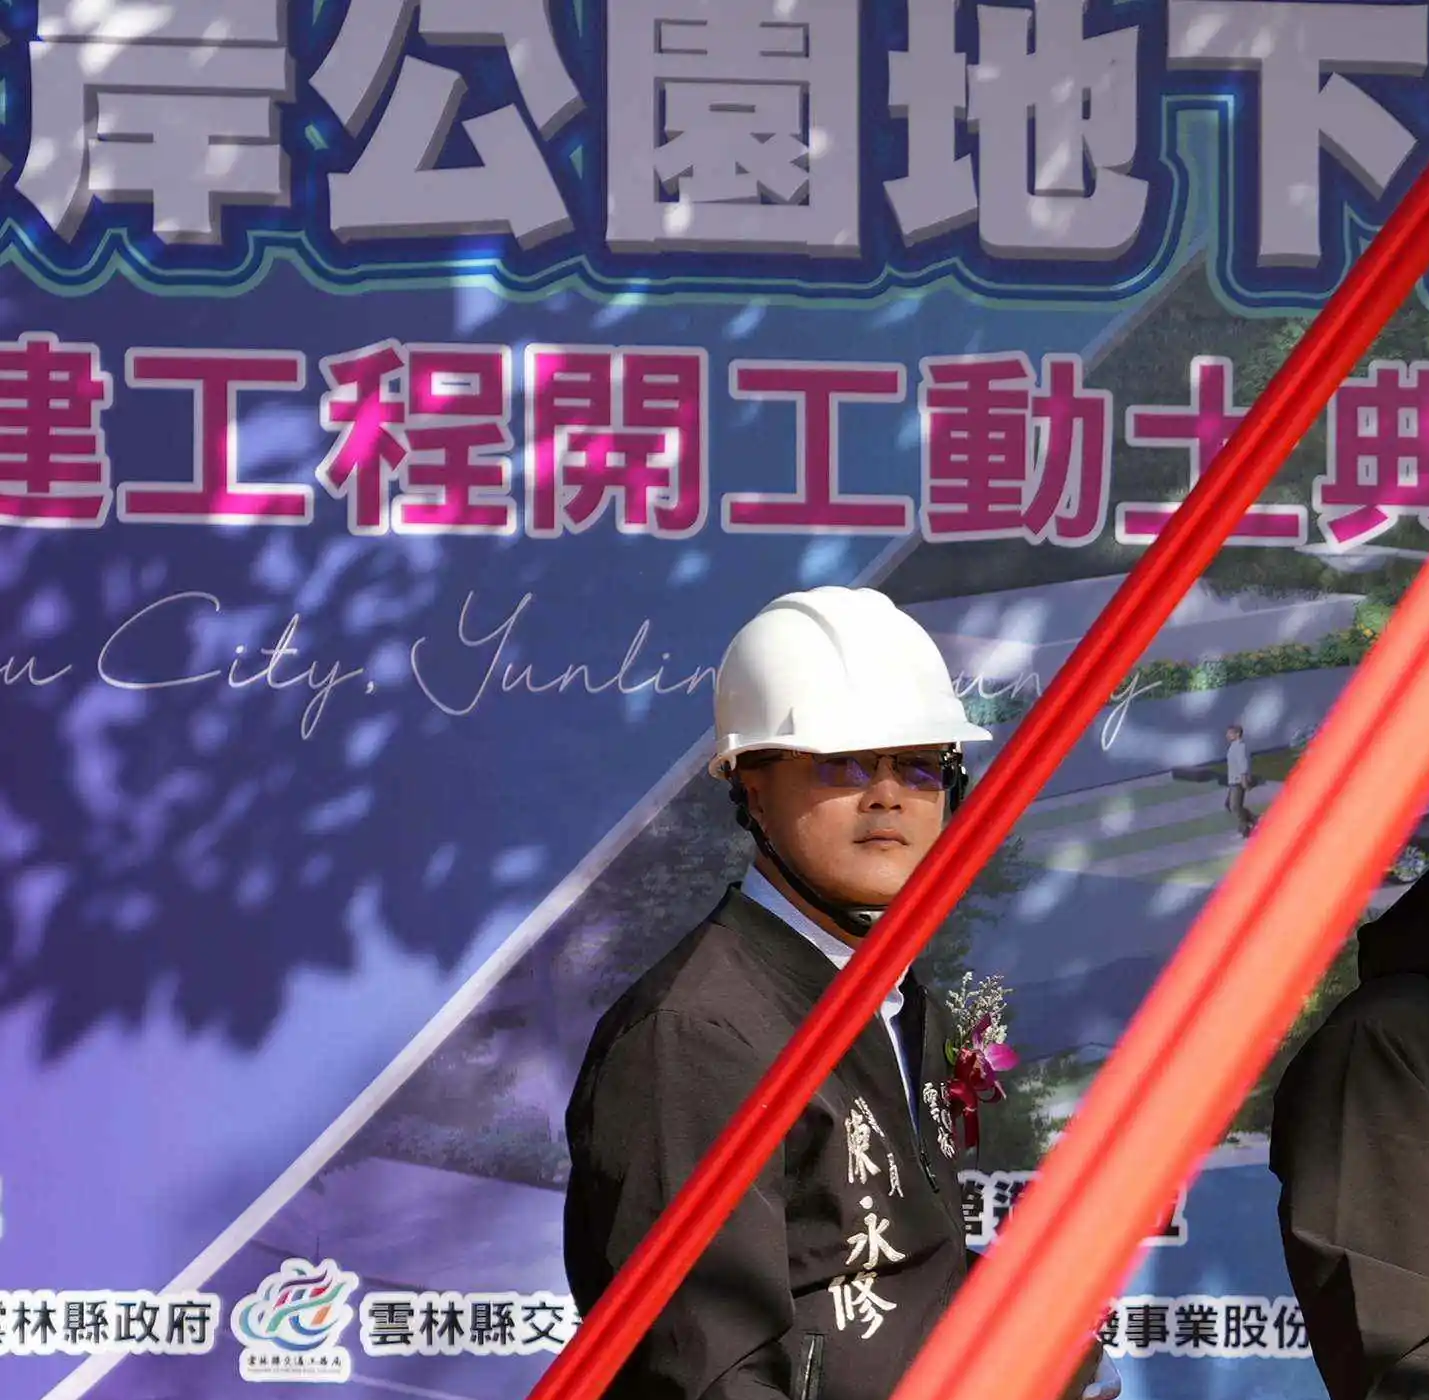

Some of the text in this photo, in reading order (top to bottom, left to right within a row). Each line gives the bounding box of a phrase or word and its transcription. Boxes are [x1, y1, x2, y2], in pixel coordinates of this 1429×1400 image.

[98, 590, 376, 740] City,
[828, 1108, 906, 1340] 陳永修
[0, 1300, 211, 1346] 林縣政府
[367, 1300, 584, 1346] 雲林縣交
